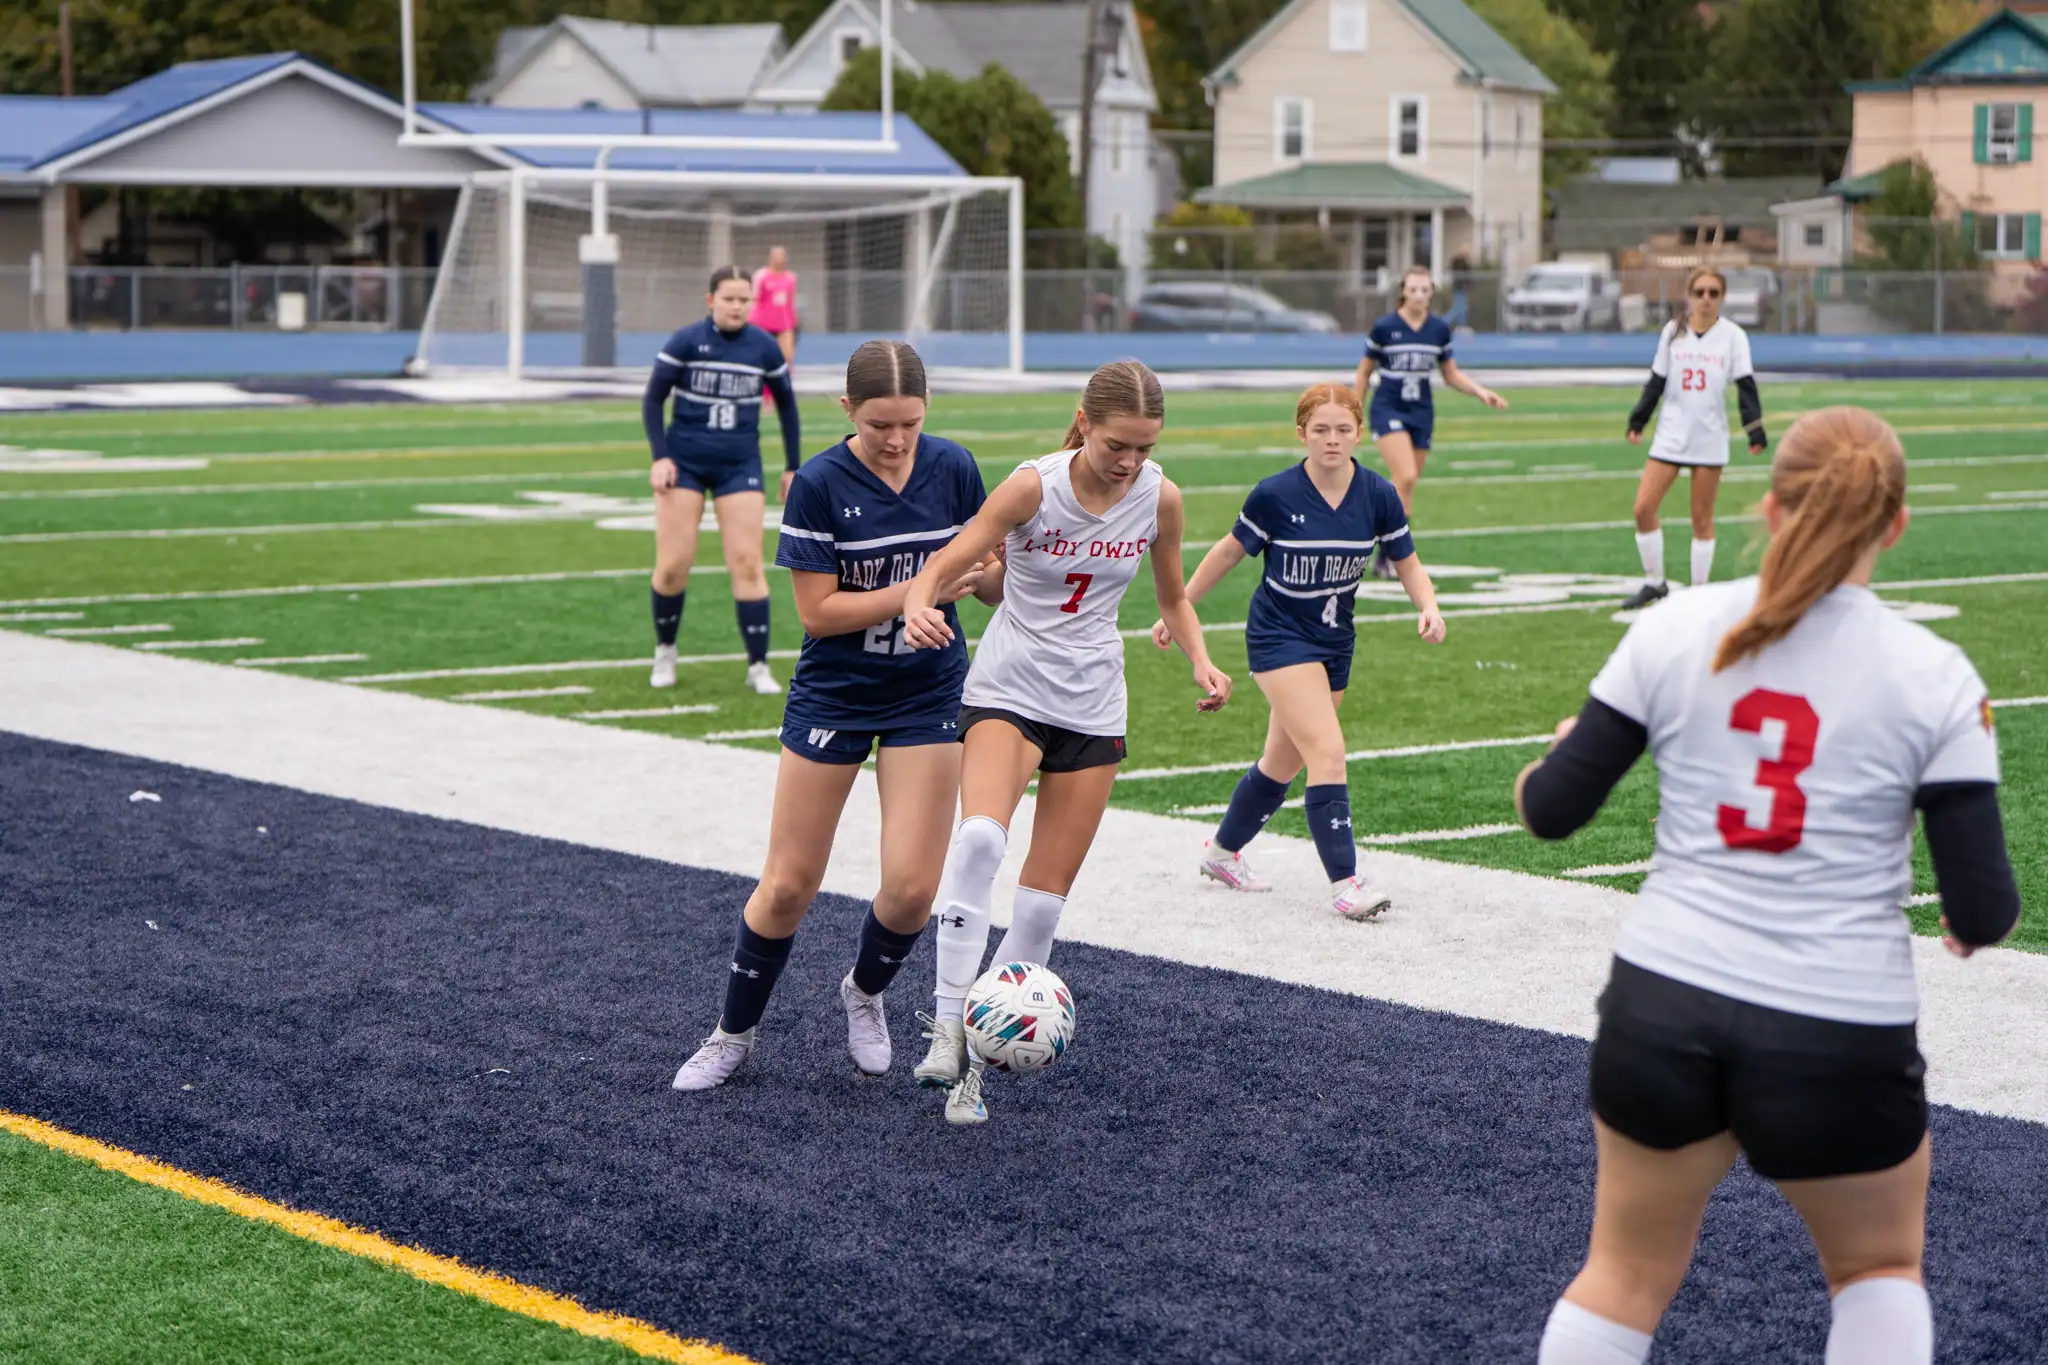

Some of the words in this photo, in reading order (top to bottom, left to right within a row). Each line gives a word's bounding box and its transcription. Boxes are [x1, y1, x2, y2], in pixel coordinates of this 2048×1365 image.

[1682, 367, 1706, 390] 23
[707, 403, 735, 429] 18
[841, 557, 885, 591] LADY
[1282, 553, 1319, 585] LADY
[1060, 573, 1094, 614] 7
[1321, 594, 1339, 628] 4
[1716, 686, 1821, 854] 3
